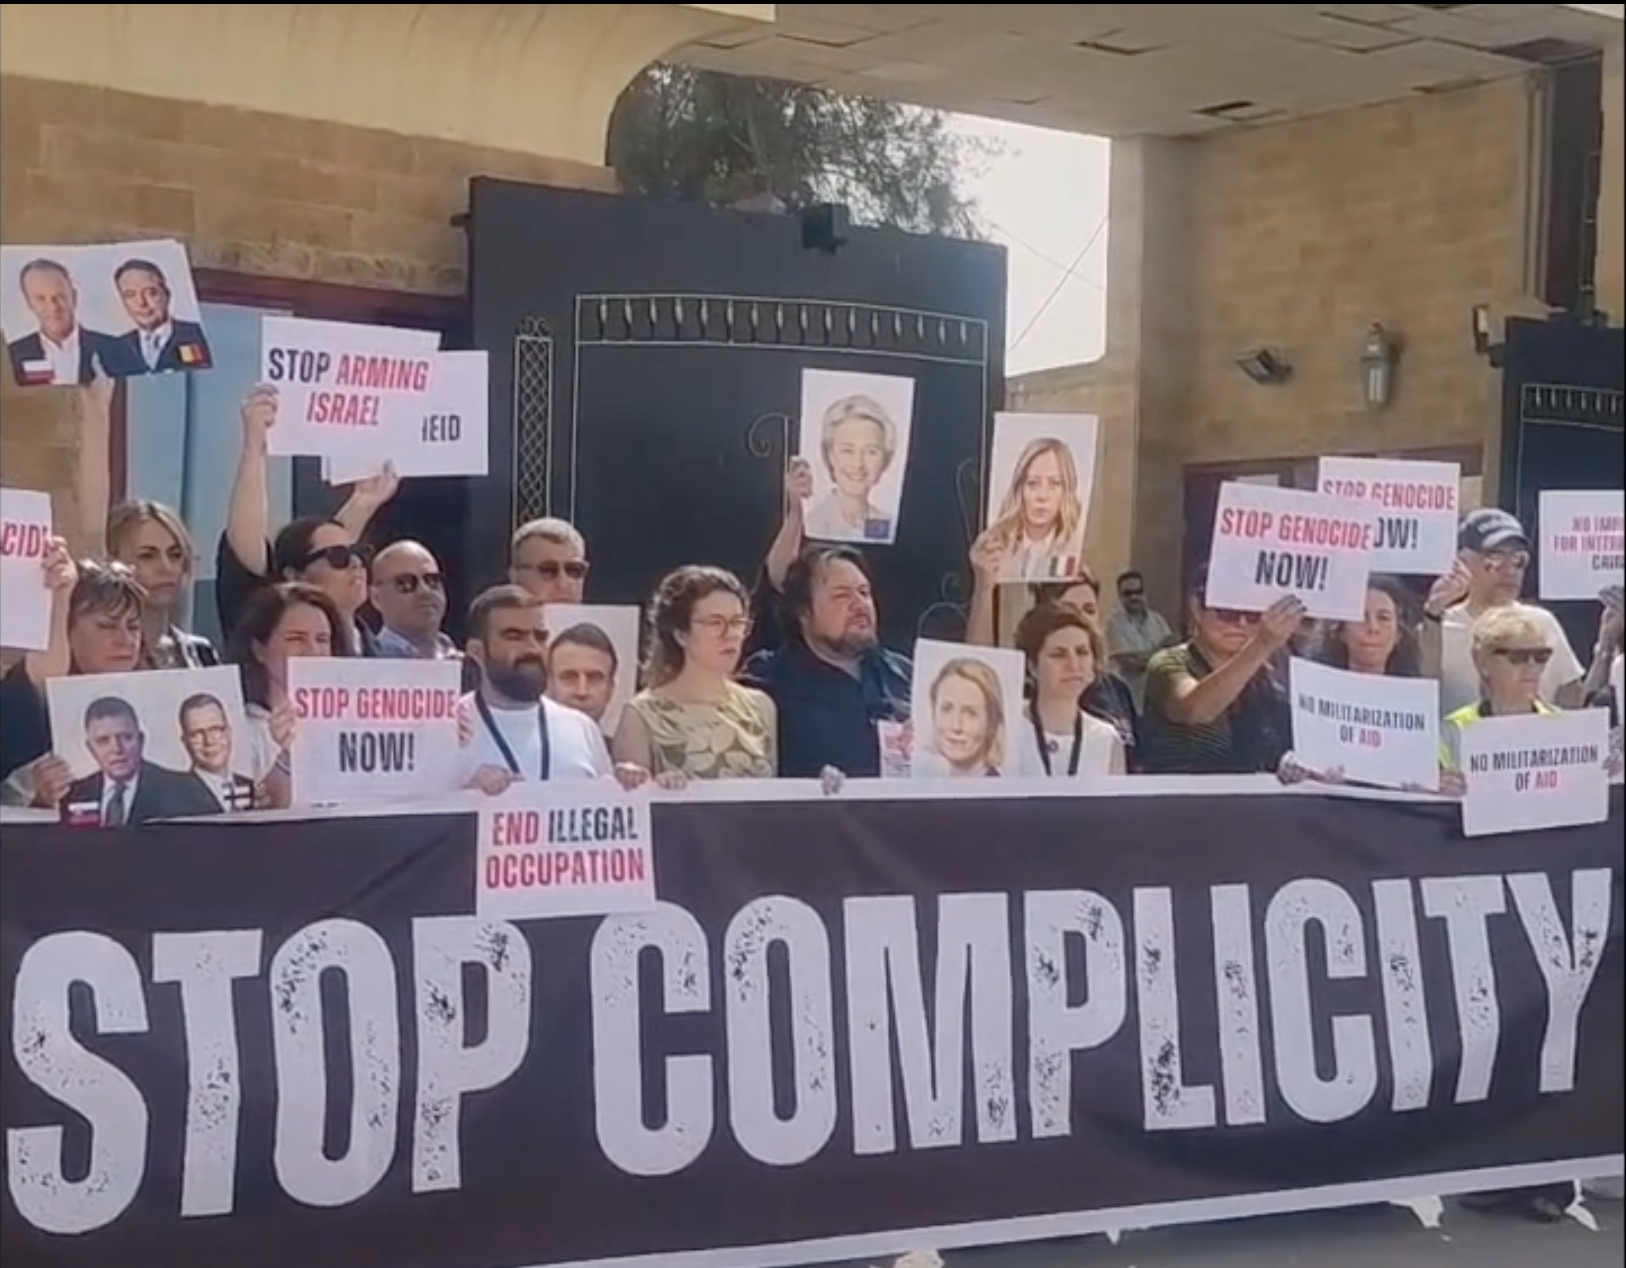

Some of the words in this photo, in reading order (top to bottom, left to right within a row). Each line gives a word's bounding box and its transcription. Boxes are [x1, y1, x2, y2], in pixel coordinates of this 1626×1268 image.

[268, 348, 331, 384] STOP
[335, 353, 430, 392] ARMING
[306, 391, 380, 426] ISRAEL
[1322, 479, 1367, 498] STOP
[1370, 482, 1456, 511] GENOCIDE
[1219, 507, 1274, 538] STOP
[1278, 513, 1373, 550] GENOCIDE
[1254, 551, 1329, 591] NOW!
[295, 687, 350, 719] STOP
[356, 687, 455, 720] GENOCIDE
[1298, 693, 1315, 714] NO
[1318, 699, 1425, 731] MILITARIZATION
[338, 731, 415, 772] NOW!
[1339, 724, 1353, 743] OF
[1358, 728, 1382, 748] AID
[1470, 753, 1489, 773] NO
[1492, 745, 1599, 770] MILITARIZATION
[1514, 772, 1530, 792] OF
[1534, 770, 1558, 789] AID
[492, 810, 540, 846] END
[548, 806, 638, 844] ILLEGAL
[485, 848, 645, 889] OCCUPATION
[7, 914, 531, 1235] STOP
[589, 868, 1612, 1176] COMPLICITY
